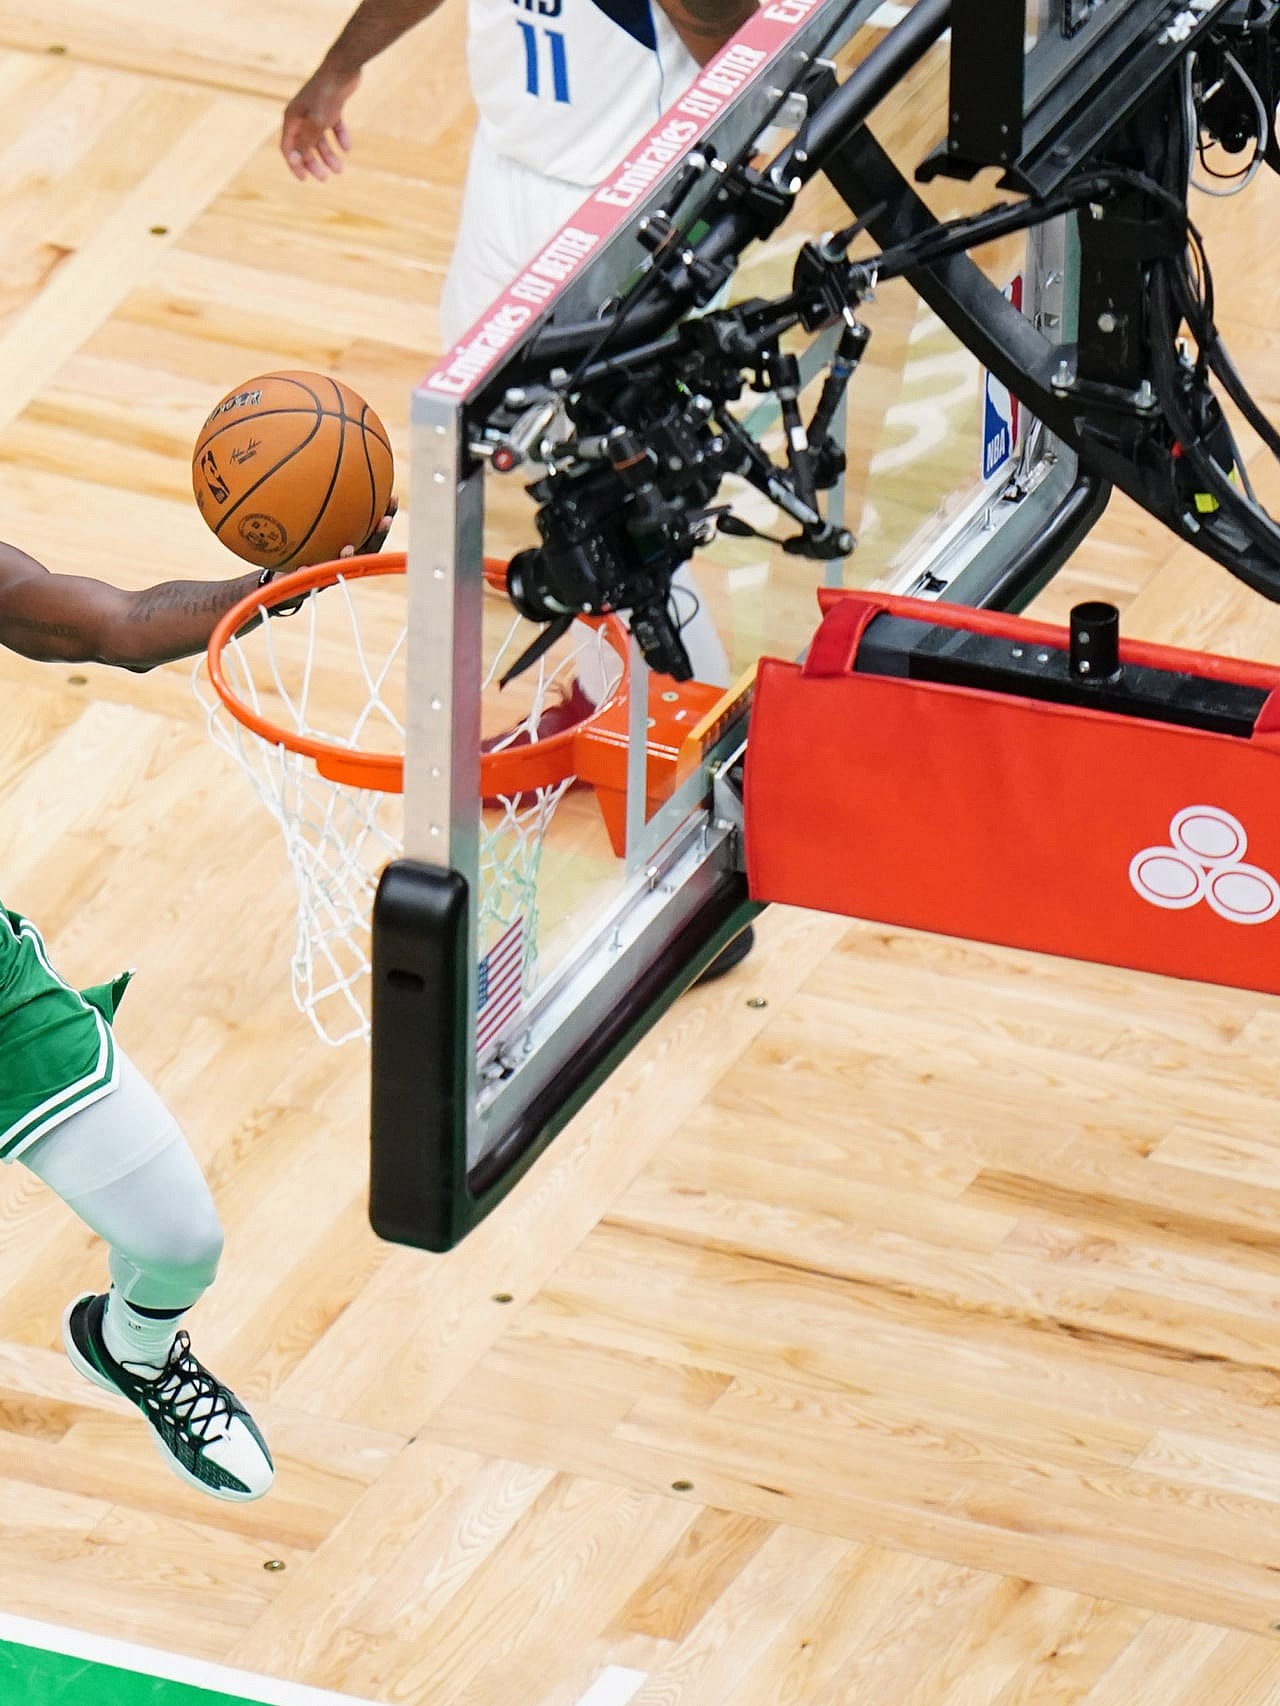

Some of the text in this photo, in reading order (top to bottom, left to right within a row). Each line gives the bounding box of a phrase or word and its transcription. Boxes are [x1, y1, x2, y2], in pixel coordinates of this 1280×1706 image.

[516, 18, 570, 104] 11
[595, 43, 768, 208] Emirates FLY BETTER
[427, 226, 600, 394] Emirates FLY BETTER
[986, 427, 1006, 472] NBA
